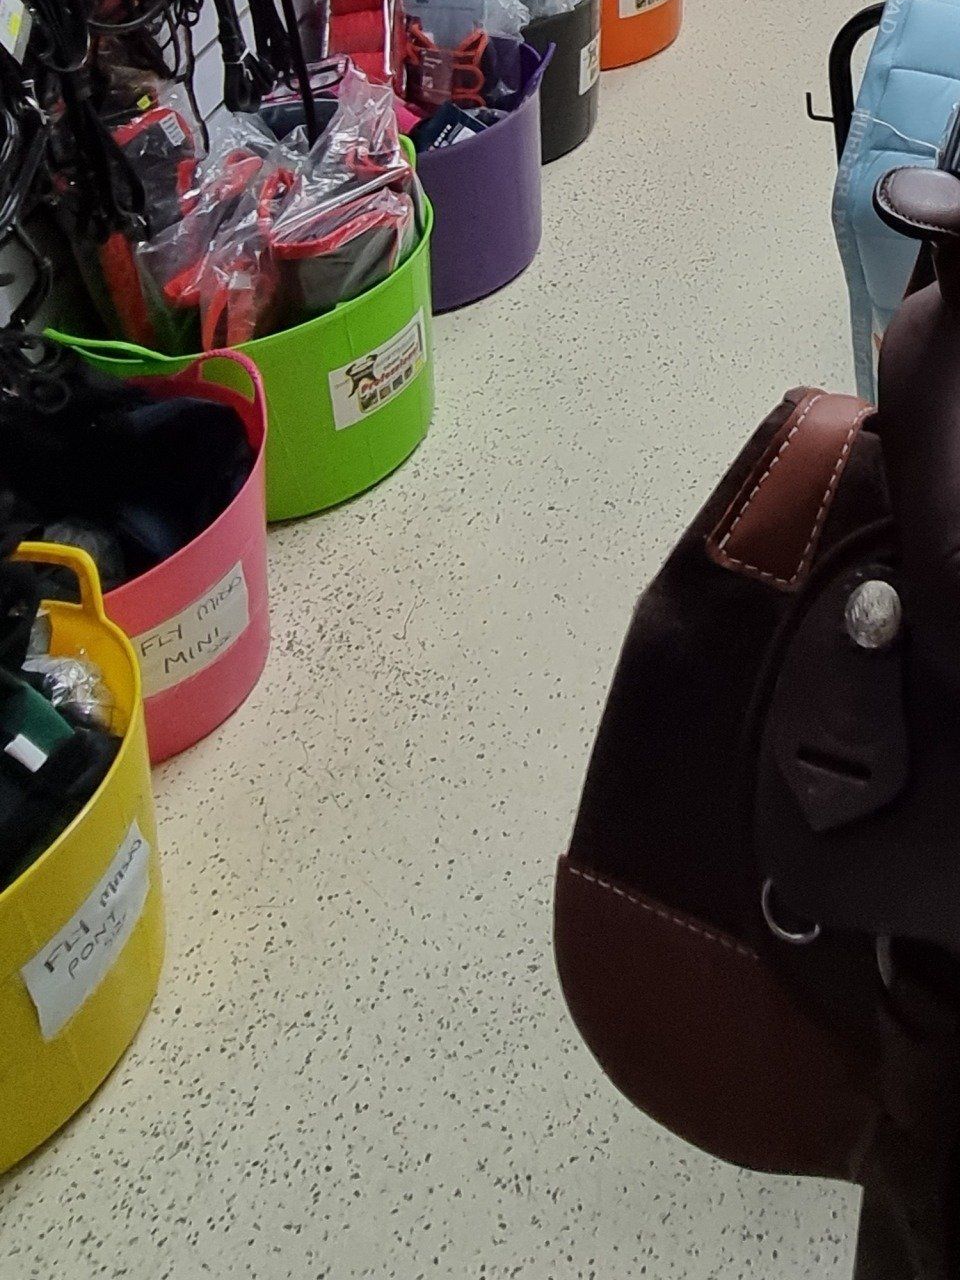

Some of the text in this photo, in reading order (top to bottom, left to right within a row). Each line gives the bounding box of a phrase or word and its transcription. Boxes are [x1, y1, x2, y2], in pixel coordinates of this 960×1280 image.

[140, 624, 183, 658] FLY
[164, 626, 220, 674] MINI
[43, 919, 91, 974] FLY
[67, 909, 117, 980] PONY
